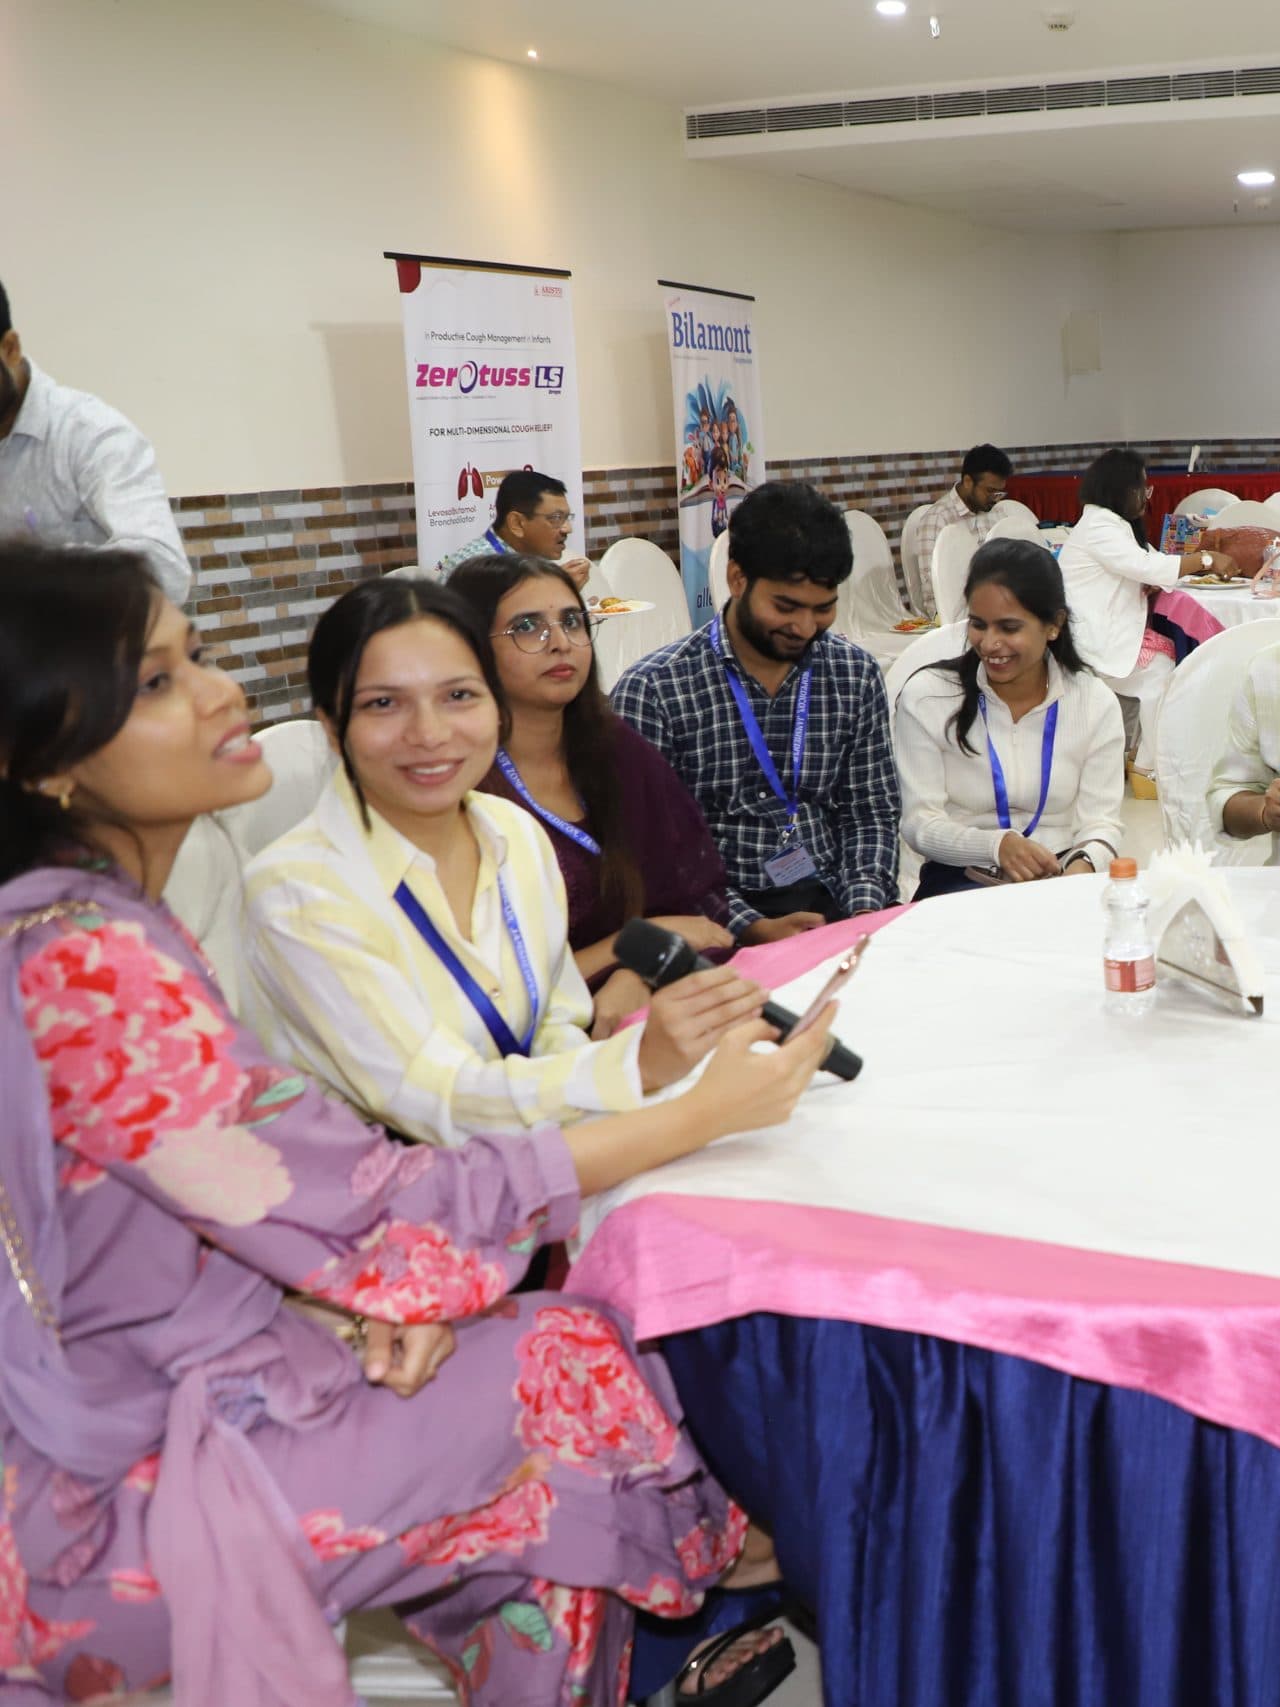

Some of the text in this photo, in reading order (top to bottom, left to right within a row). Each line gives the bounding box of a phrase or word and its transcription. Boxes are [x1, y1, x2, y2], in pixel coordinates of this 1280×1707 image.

[431, 331, 465, 341] Productive
[466, 333, 486, 343] Cough
[487, 334, 526, 344] Management
[532, 336, 551, 344] Infants
[671, 312, 752, 354] Bilamont
[538, 368, 561, 388] LS
[429, 428, 445, 436] FOR
[447, 426, 510, 435] MULTI-DIMENSIONAL
[511, 425, 533, 433] COUGH
